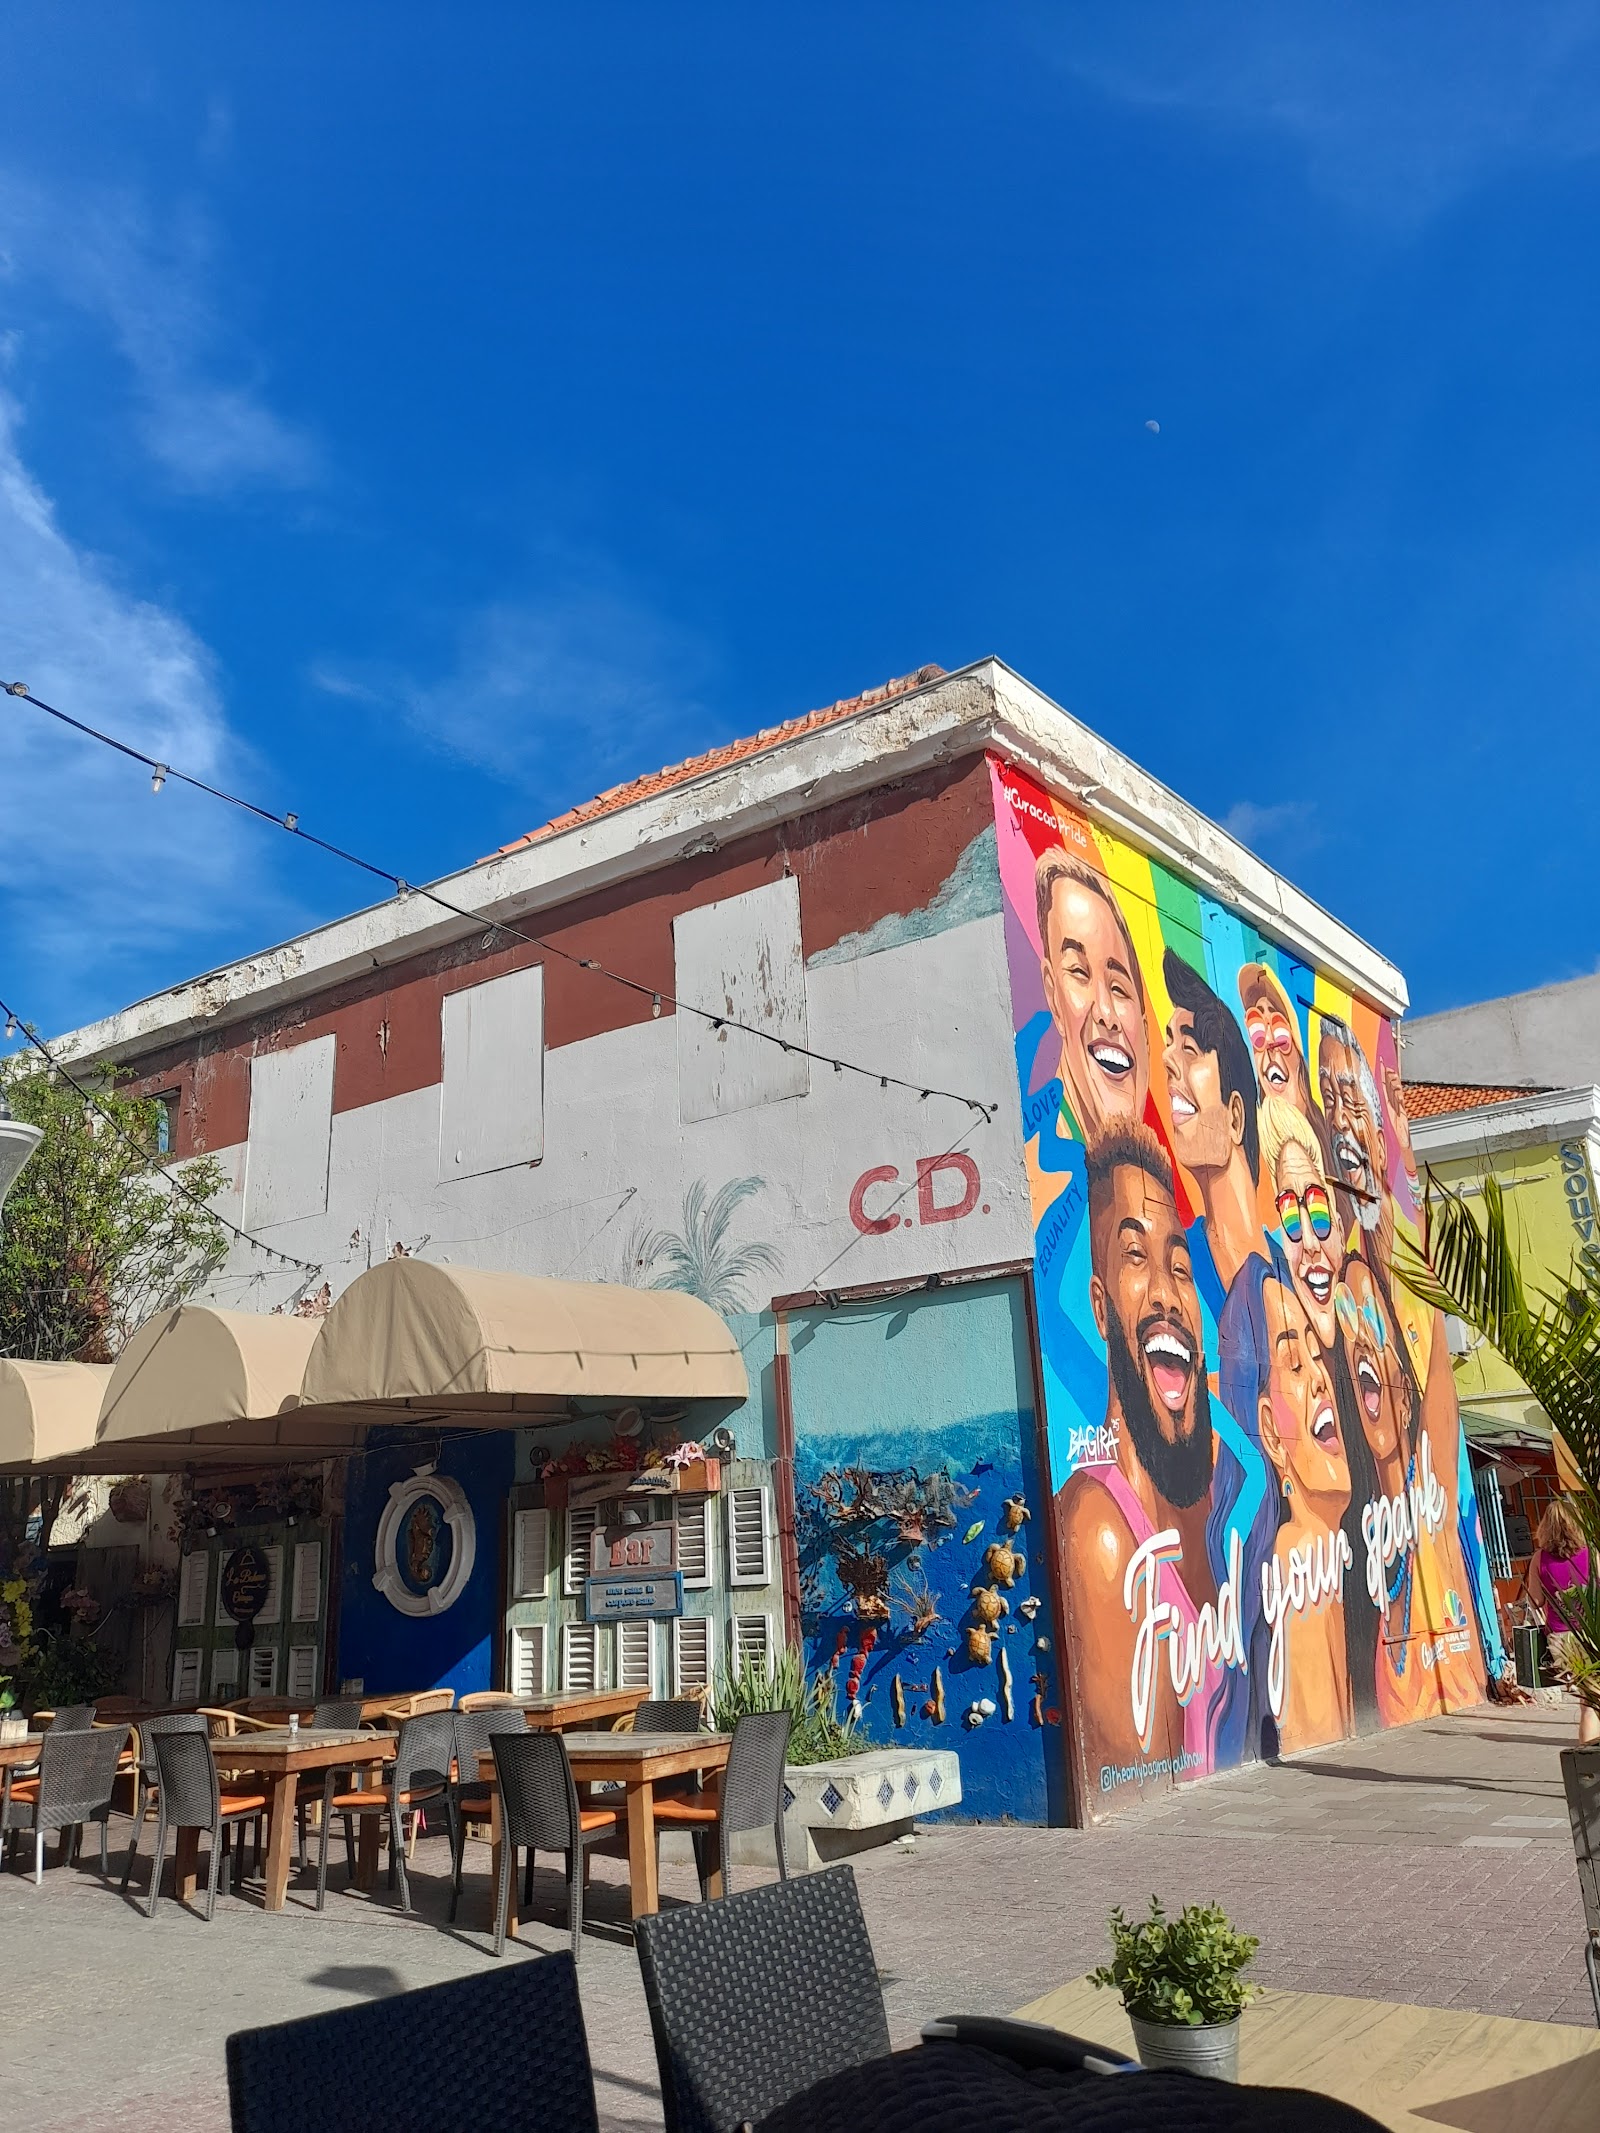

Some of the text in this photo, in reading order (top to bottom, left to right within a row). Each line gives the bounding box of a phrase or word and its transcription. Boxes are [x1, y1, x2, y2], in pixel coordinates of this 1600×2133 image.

[1023, 1087, 1060, 1132] LOVE
[849, 1152, 991, 1235] C.D.
[1038, 1182, 1083, 1278] EQUALITY
[1066, 1424, 1120, 1463] BAGIRA
[610, 1537, 655, 1567] Bar
[1124, 1429, 1447, 1751] Find your spark
